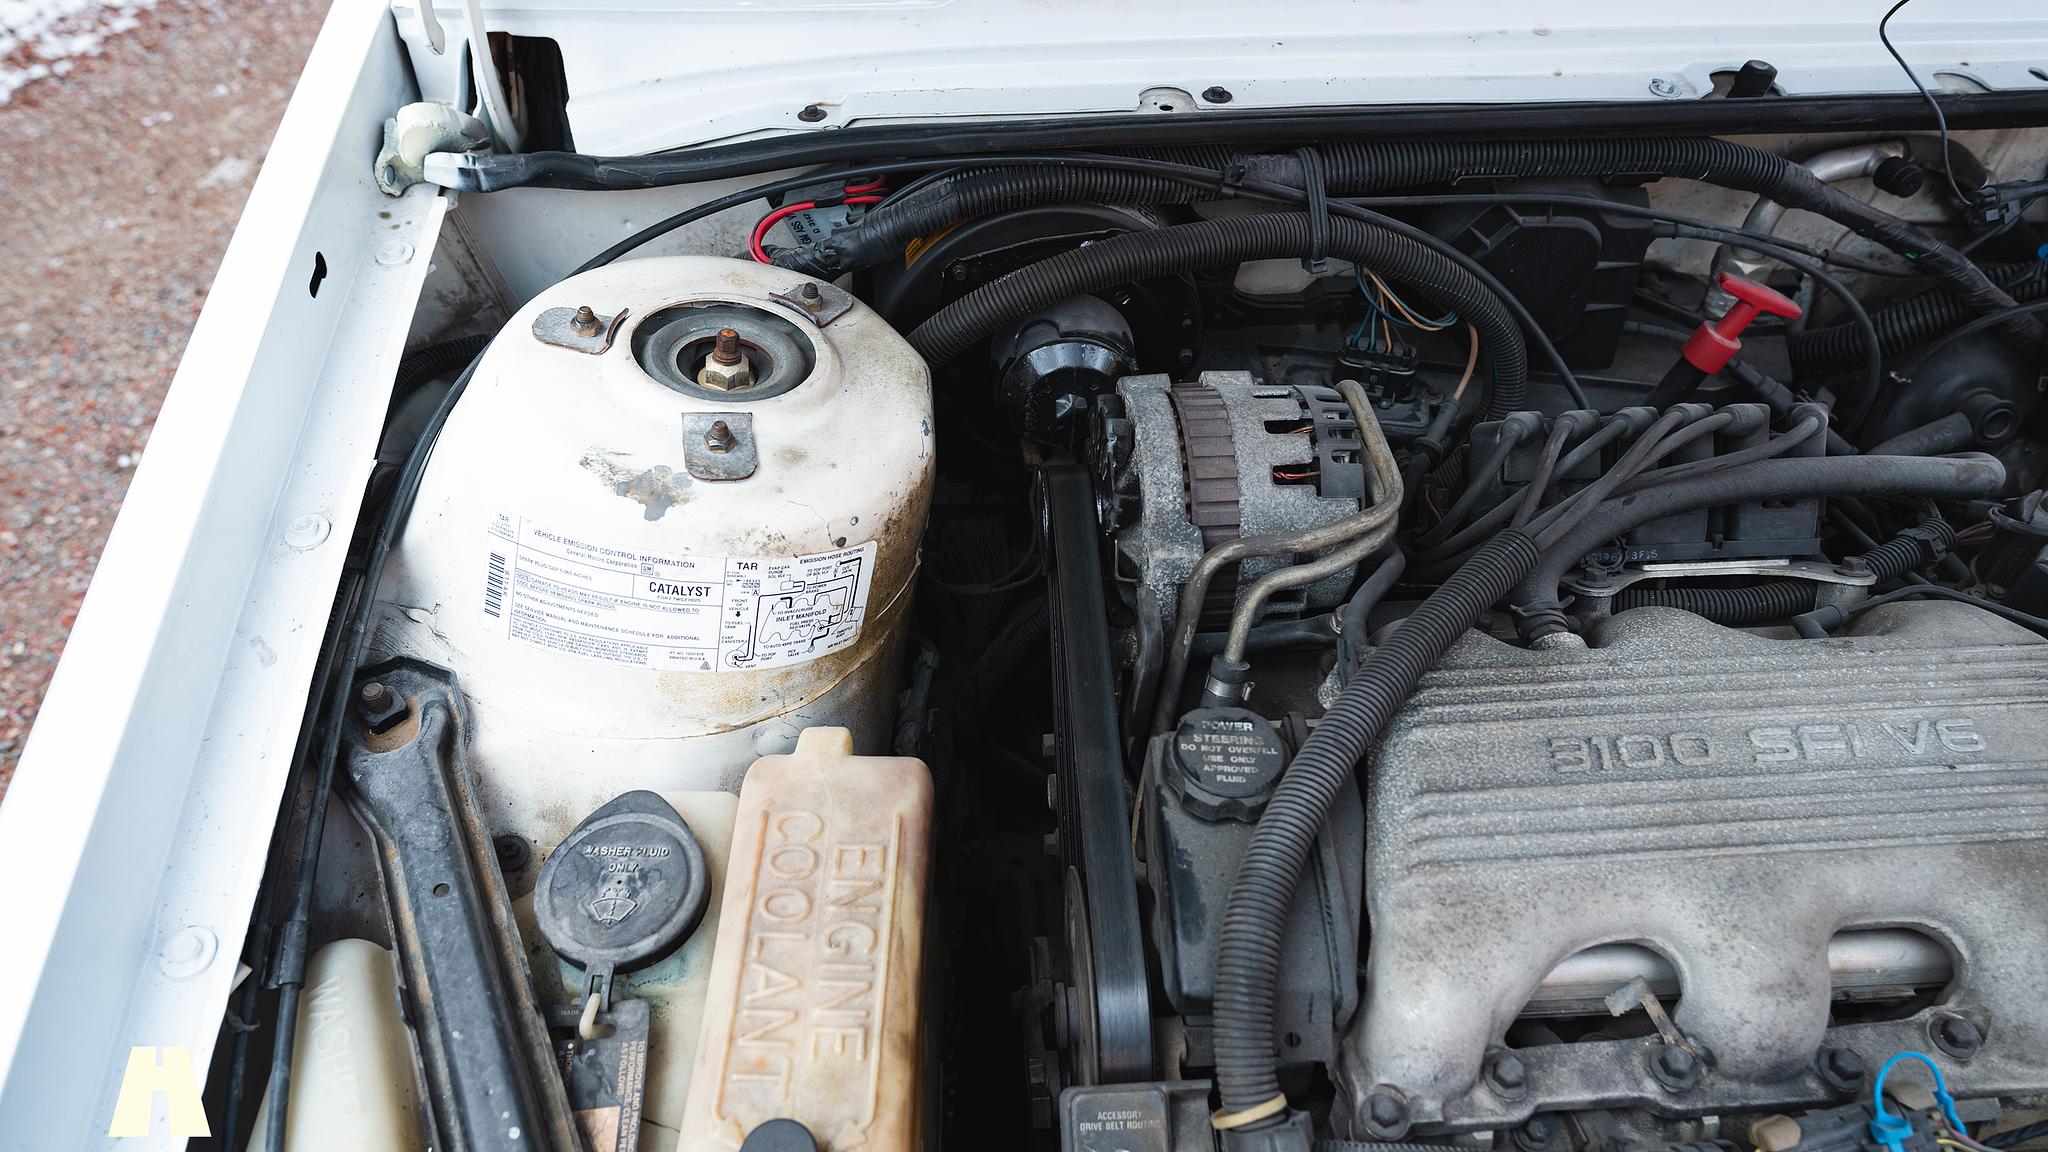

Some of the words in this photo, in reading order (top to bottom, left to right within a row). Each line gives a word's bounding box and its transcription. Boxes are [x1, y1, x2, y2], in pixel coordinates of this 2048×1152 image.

[791, 220, 806, 236] ABS
[533, 528, 562, 543] VEHICLE
[563, 538, 598, 553] EMISSION
[600, 547, 637, 561] CONTROL
[640, 555, 695, 568] INFORMATION
[800, 556, 827, 565] EMISSION
[843, 546, 865, 557] ROUTING
[737, 562, 758, 570] TAR
[649, 581, 711, 597] CATALYST
[620, 599, 641, 608] ENGINE
[796, 609, 826, 620] MANIFOLD
[1201, 721, 1254, 732] POWER
[1193, 733, 1265, 746] STEERING
[1548, 730, 1715, 774] 3100
[1746, 722, 1867, 764] SFI
[1879, 717, 1987, 756] V6
[1180, 743, 1197, 752] DO
[1200, 744, 1222, 752] NOT
[1228, 746, 1278, 755] OVERFILL
[1202, 754, 1224, 763] USE
[1230, 756, 1256, 764] ONLY
[1202, 764, 1260, 774] APPROVED
[1216, 774, 1247, 784] FLUID
[584, 845, 634, 857] WASHER
[636, 847, 671, 858] FLUID
[608, 862, 639, 873] ONLY
[731, 809, 825, 1101] COOLANT
[809, 842, 886, 1063] ENGINE
[638, 1040, 645, 1052] TO
[634, 1052, 644, 1089] IMPROVE
[632, 1092, 641, 1110] AND
[1097, 1110, 1143, 1120] ACCESSORY
[620, 1106, 631, 1137] CLEAN
[1080, 1122, 1102, 1132] DRIVE
[1105, 1121, 1124, 1131] BELT
[1126, 1120, 1162, 1130] ROUTING
